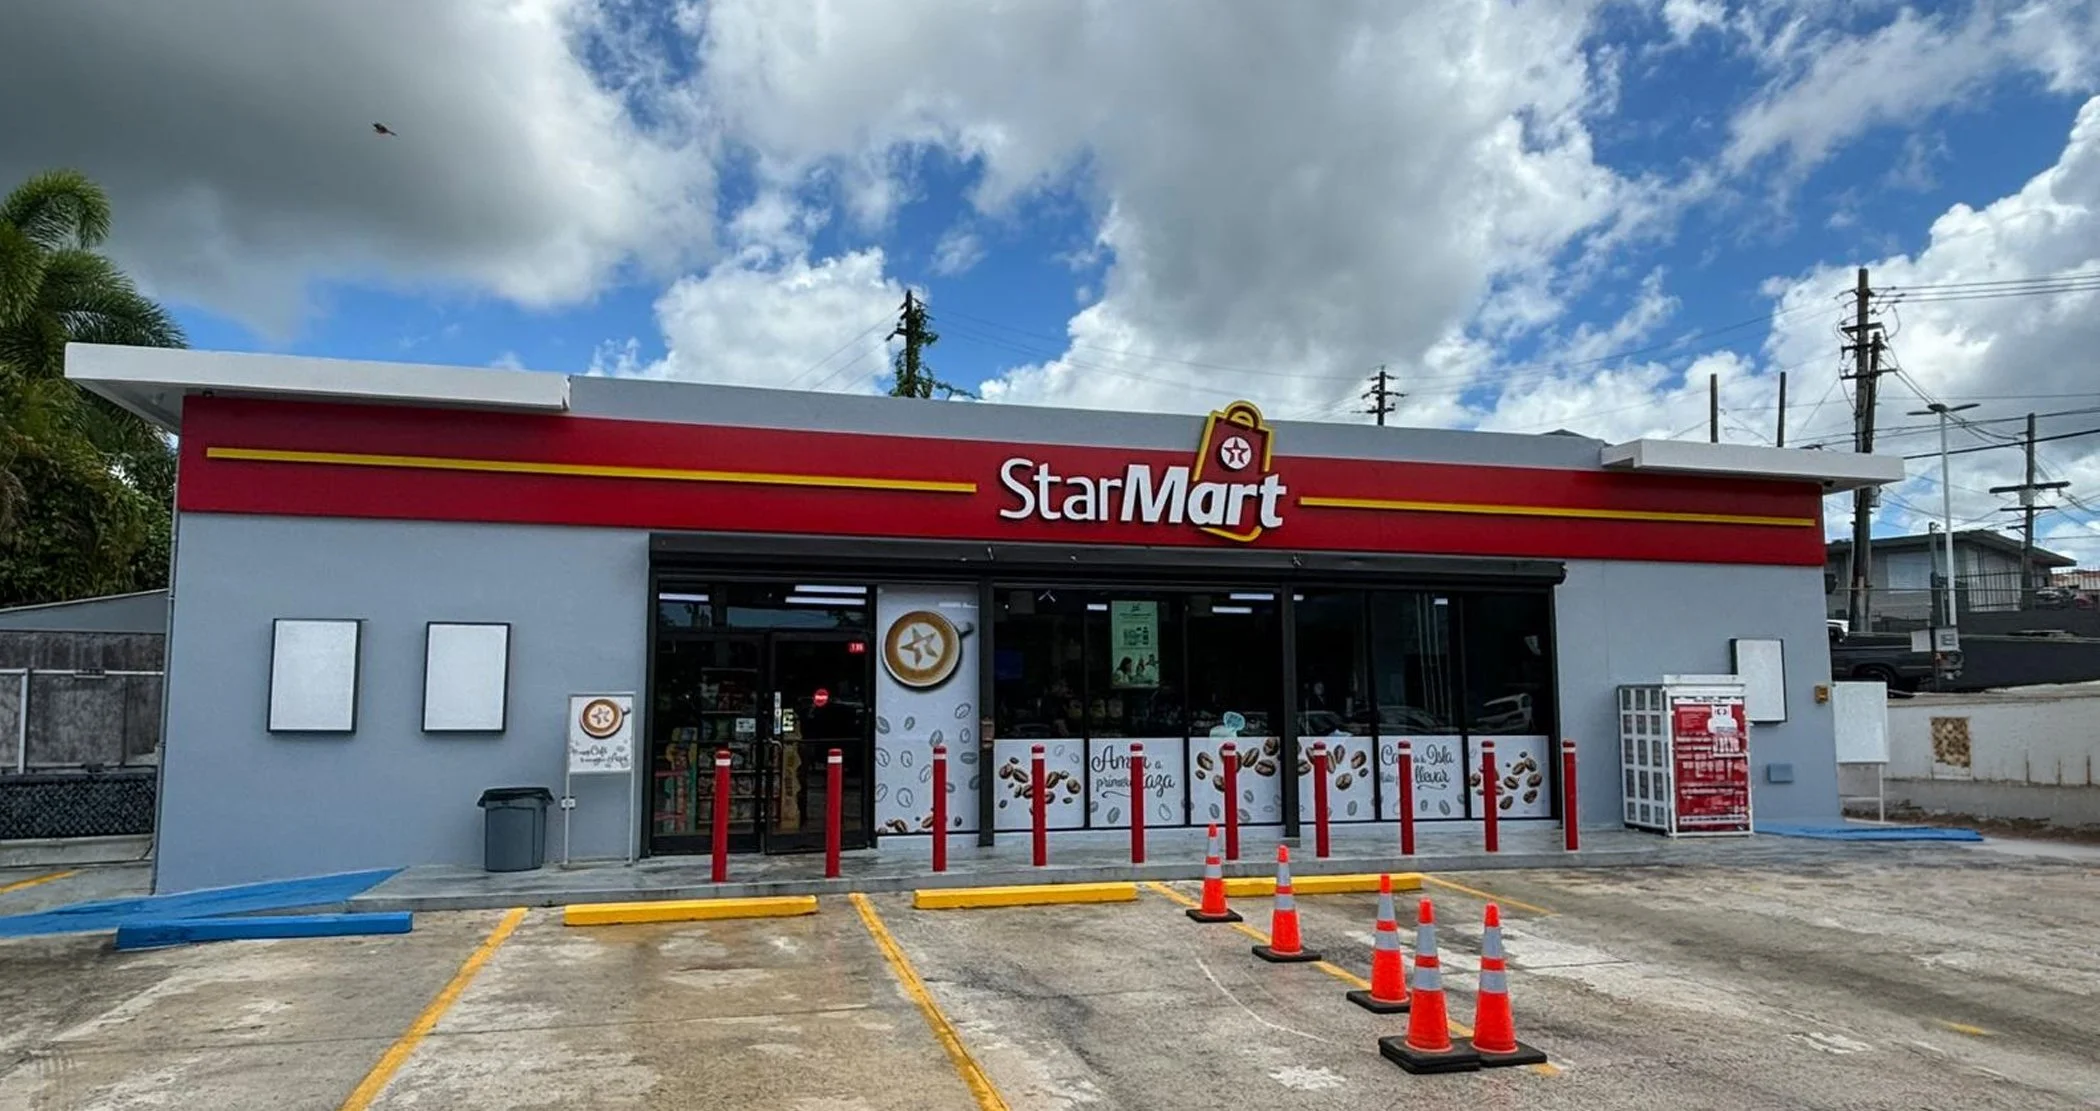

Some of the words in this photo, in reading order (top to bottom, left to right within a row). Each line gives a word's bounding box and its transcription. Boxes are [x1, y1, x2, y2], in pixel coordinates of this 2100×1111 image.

[1000, 457, 1286, 528] StarMart
[1091, 745, 1152, 773] Amr
[1426, 744, 1454, 765] Isla
[1143, 774, 1176, 797] aza
[1415, 765, 1451, 784] llevar
